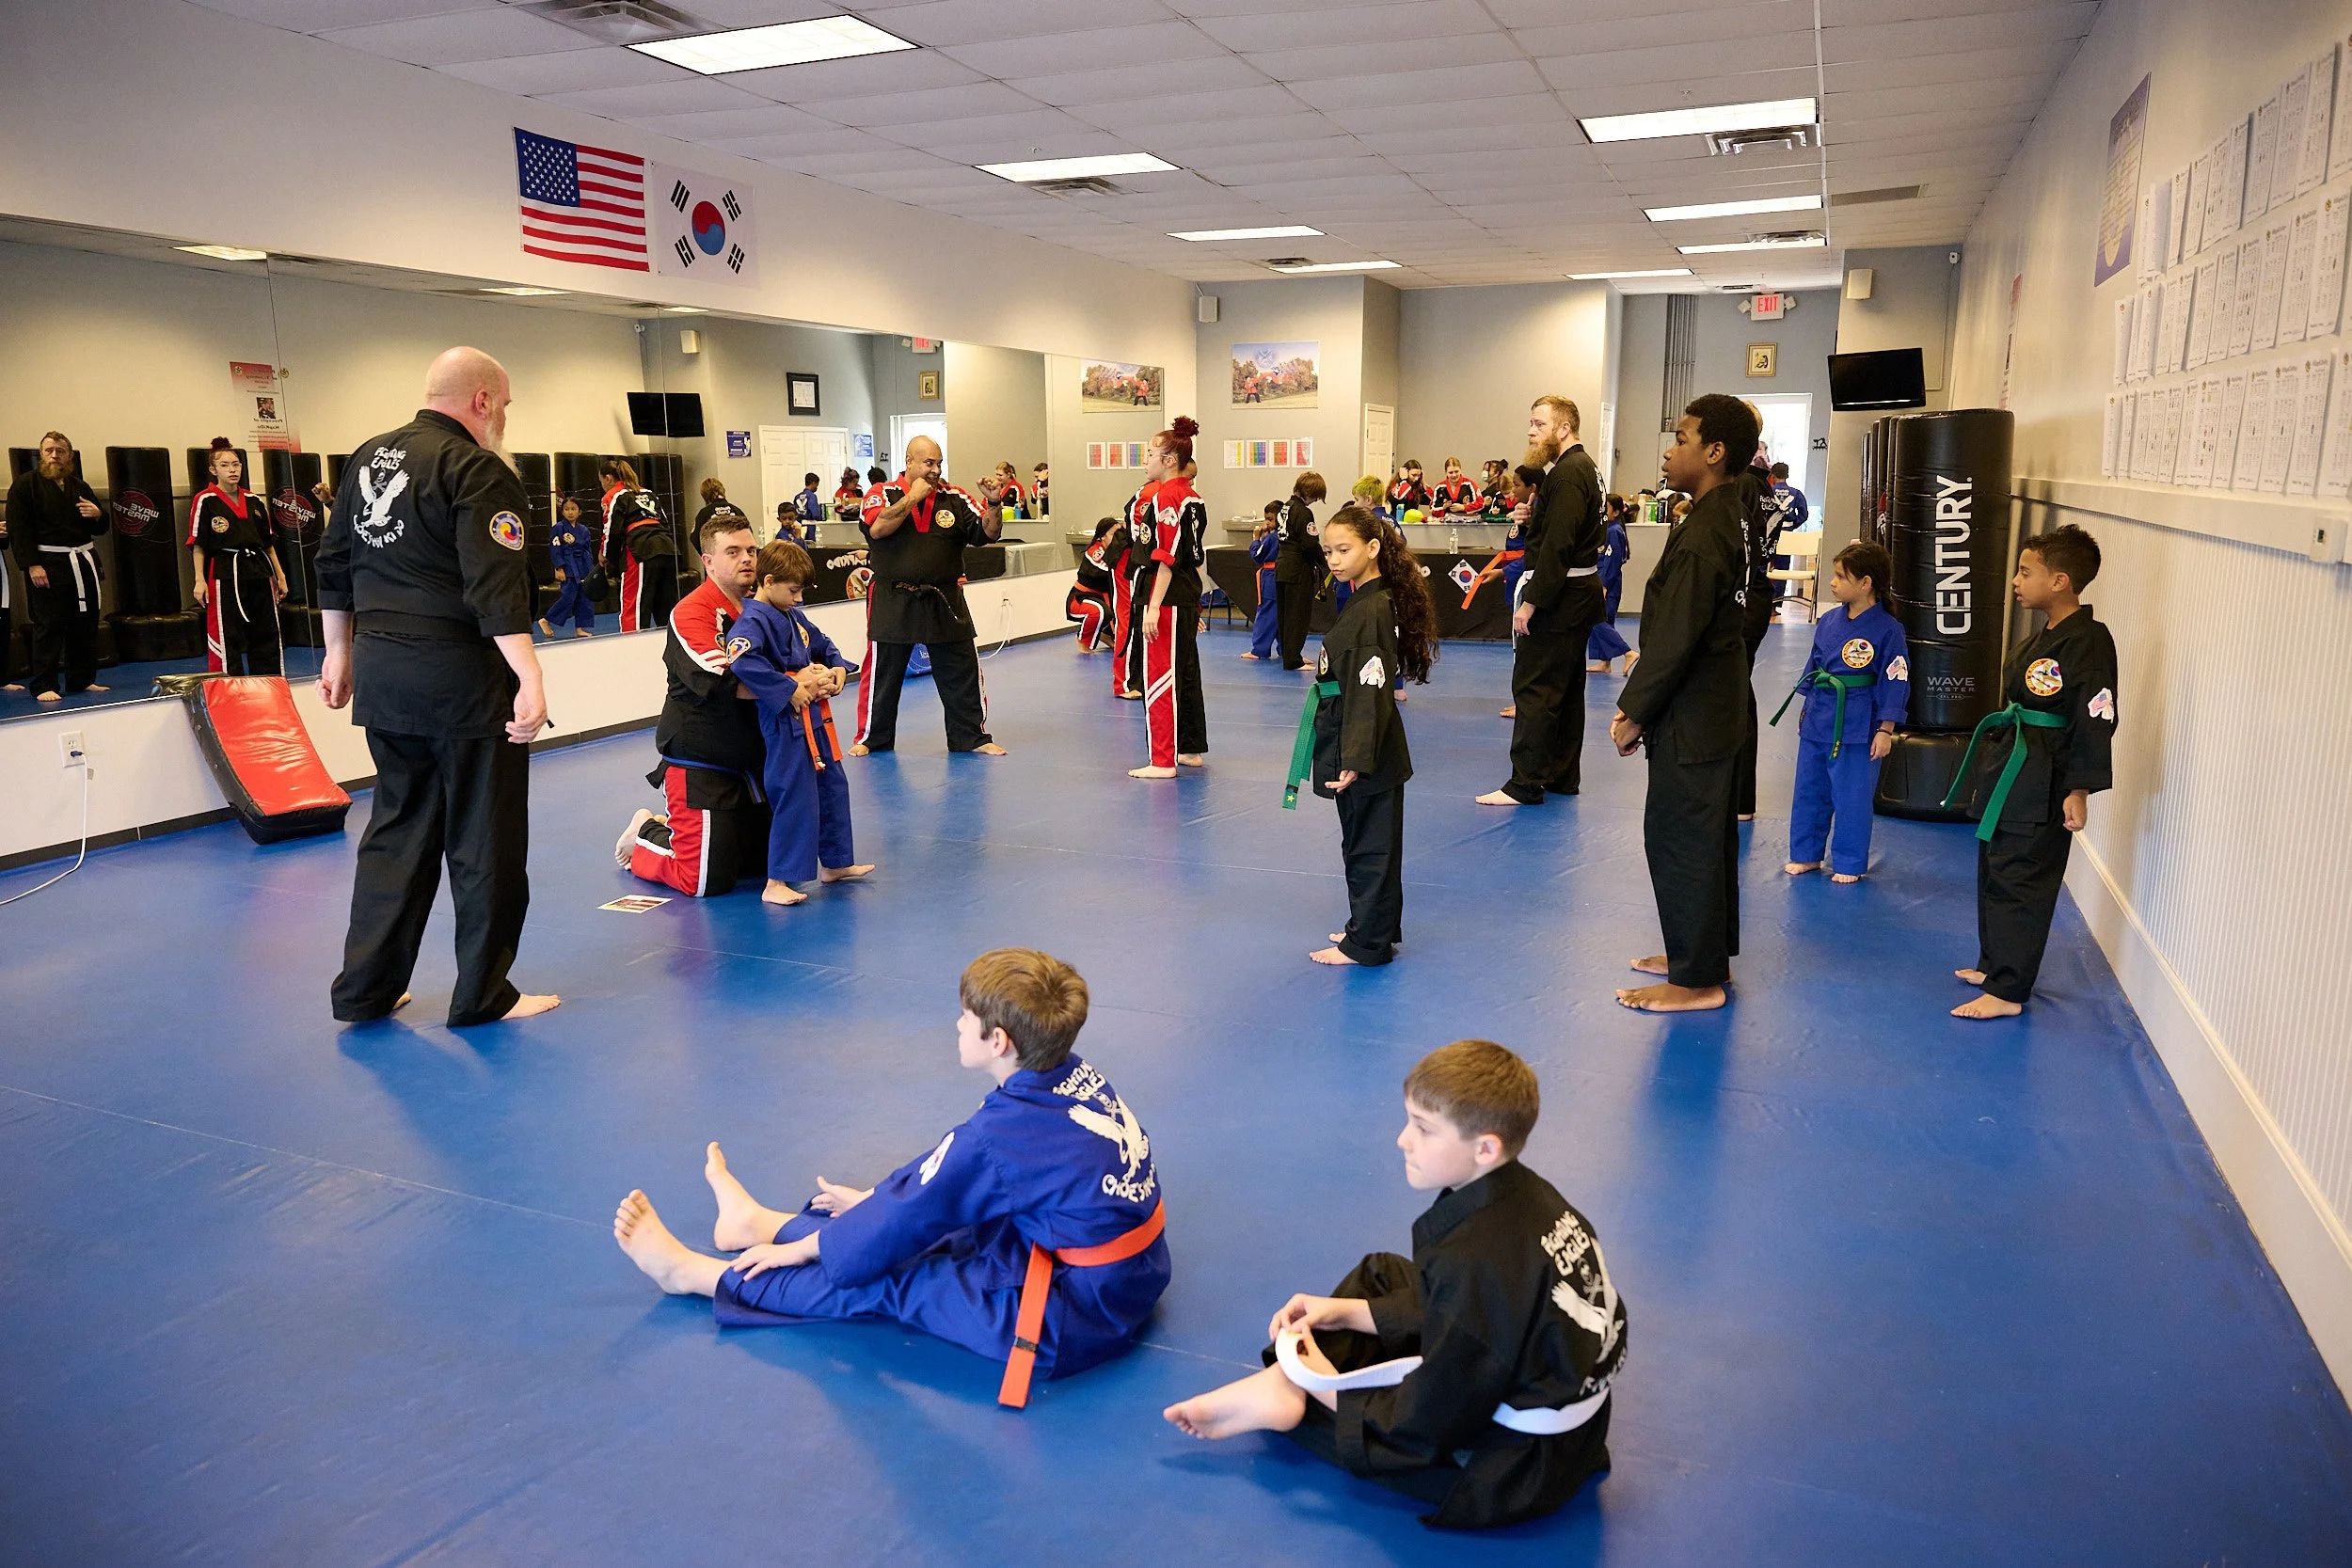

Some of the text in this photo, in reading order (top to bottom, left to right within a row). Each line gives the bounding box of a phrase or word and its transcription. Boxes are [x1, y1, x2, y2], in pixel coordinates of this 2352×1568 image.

[1757, 296, 1778, 312] EXIT
[371, 457, 401, 470] EAGLES
[1928, 676, 1975, 686] WAVE
